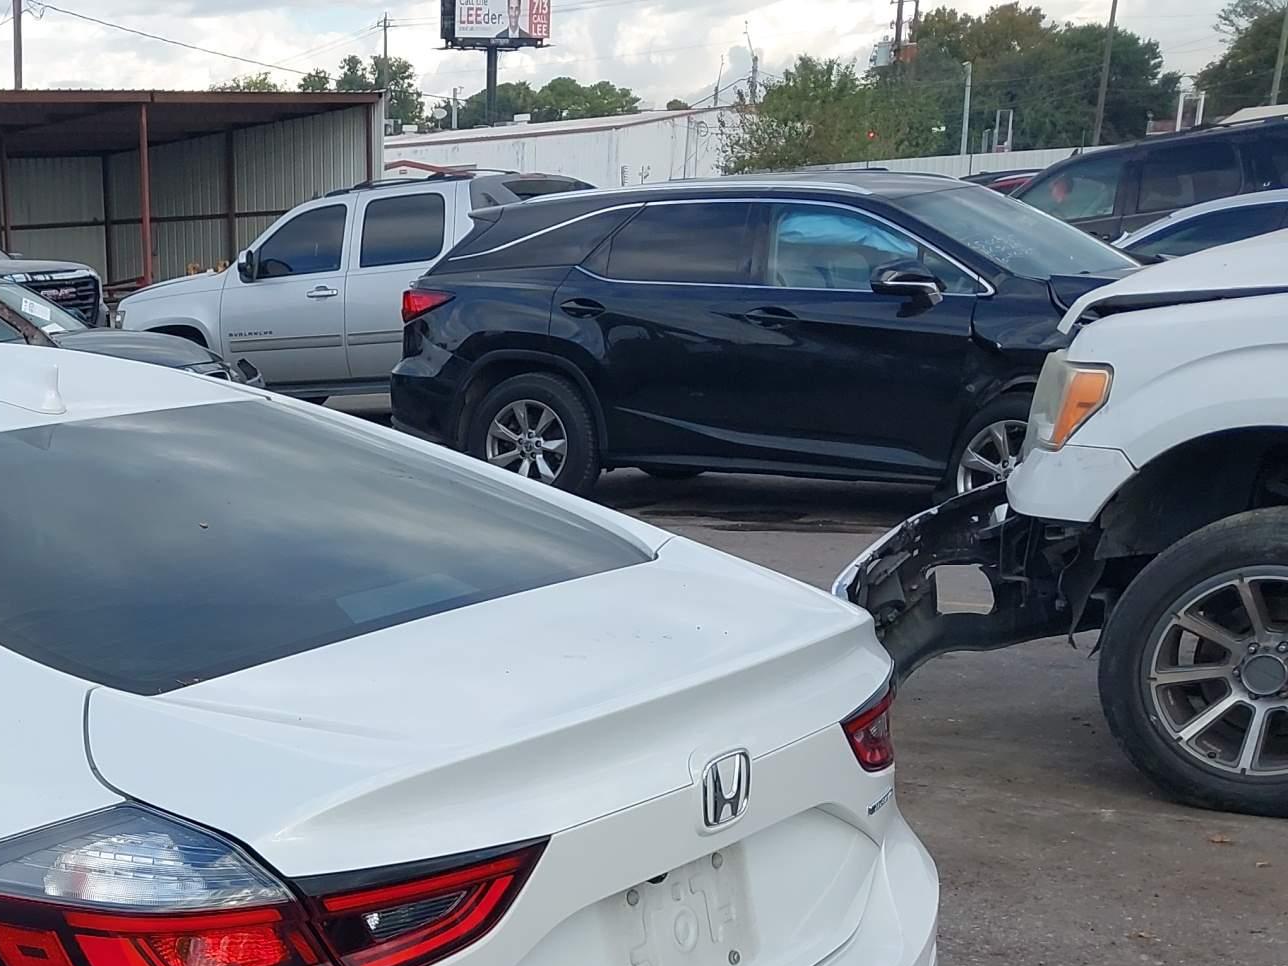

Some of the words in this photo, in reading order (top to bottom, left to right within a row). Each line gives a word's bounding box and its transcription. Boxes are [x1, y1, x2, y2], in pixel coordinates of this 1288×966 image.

[459, 7, 504, 25] LEEder.
[532, 14, 547, 23] CALL
[532, 24, 548, 36] LEE
